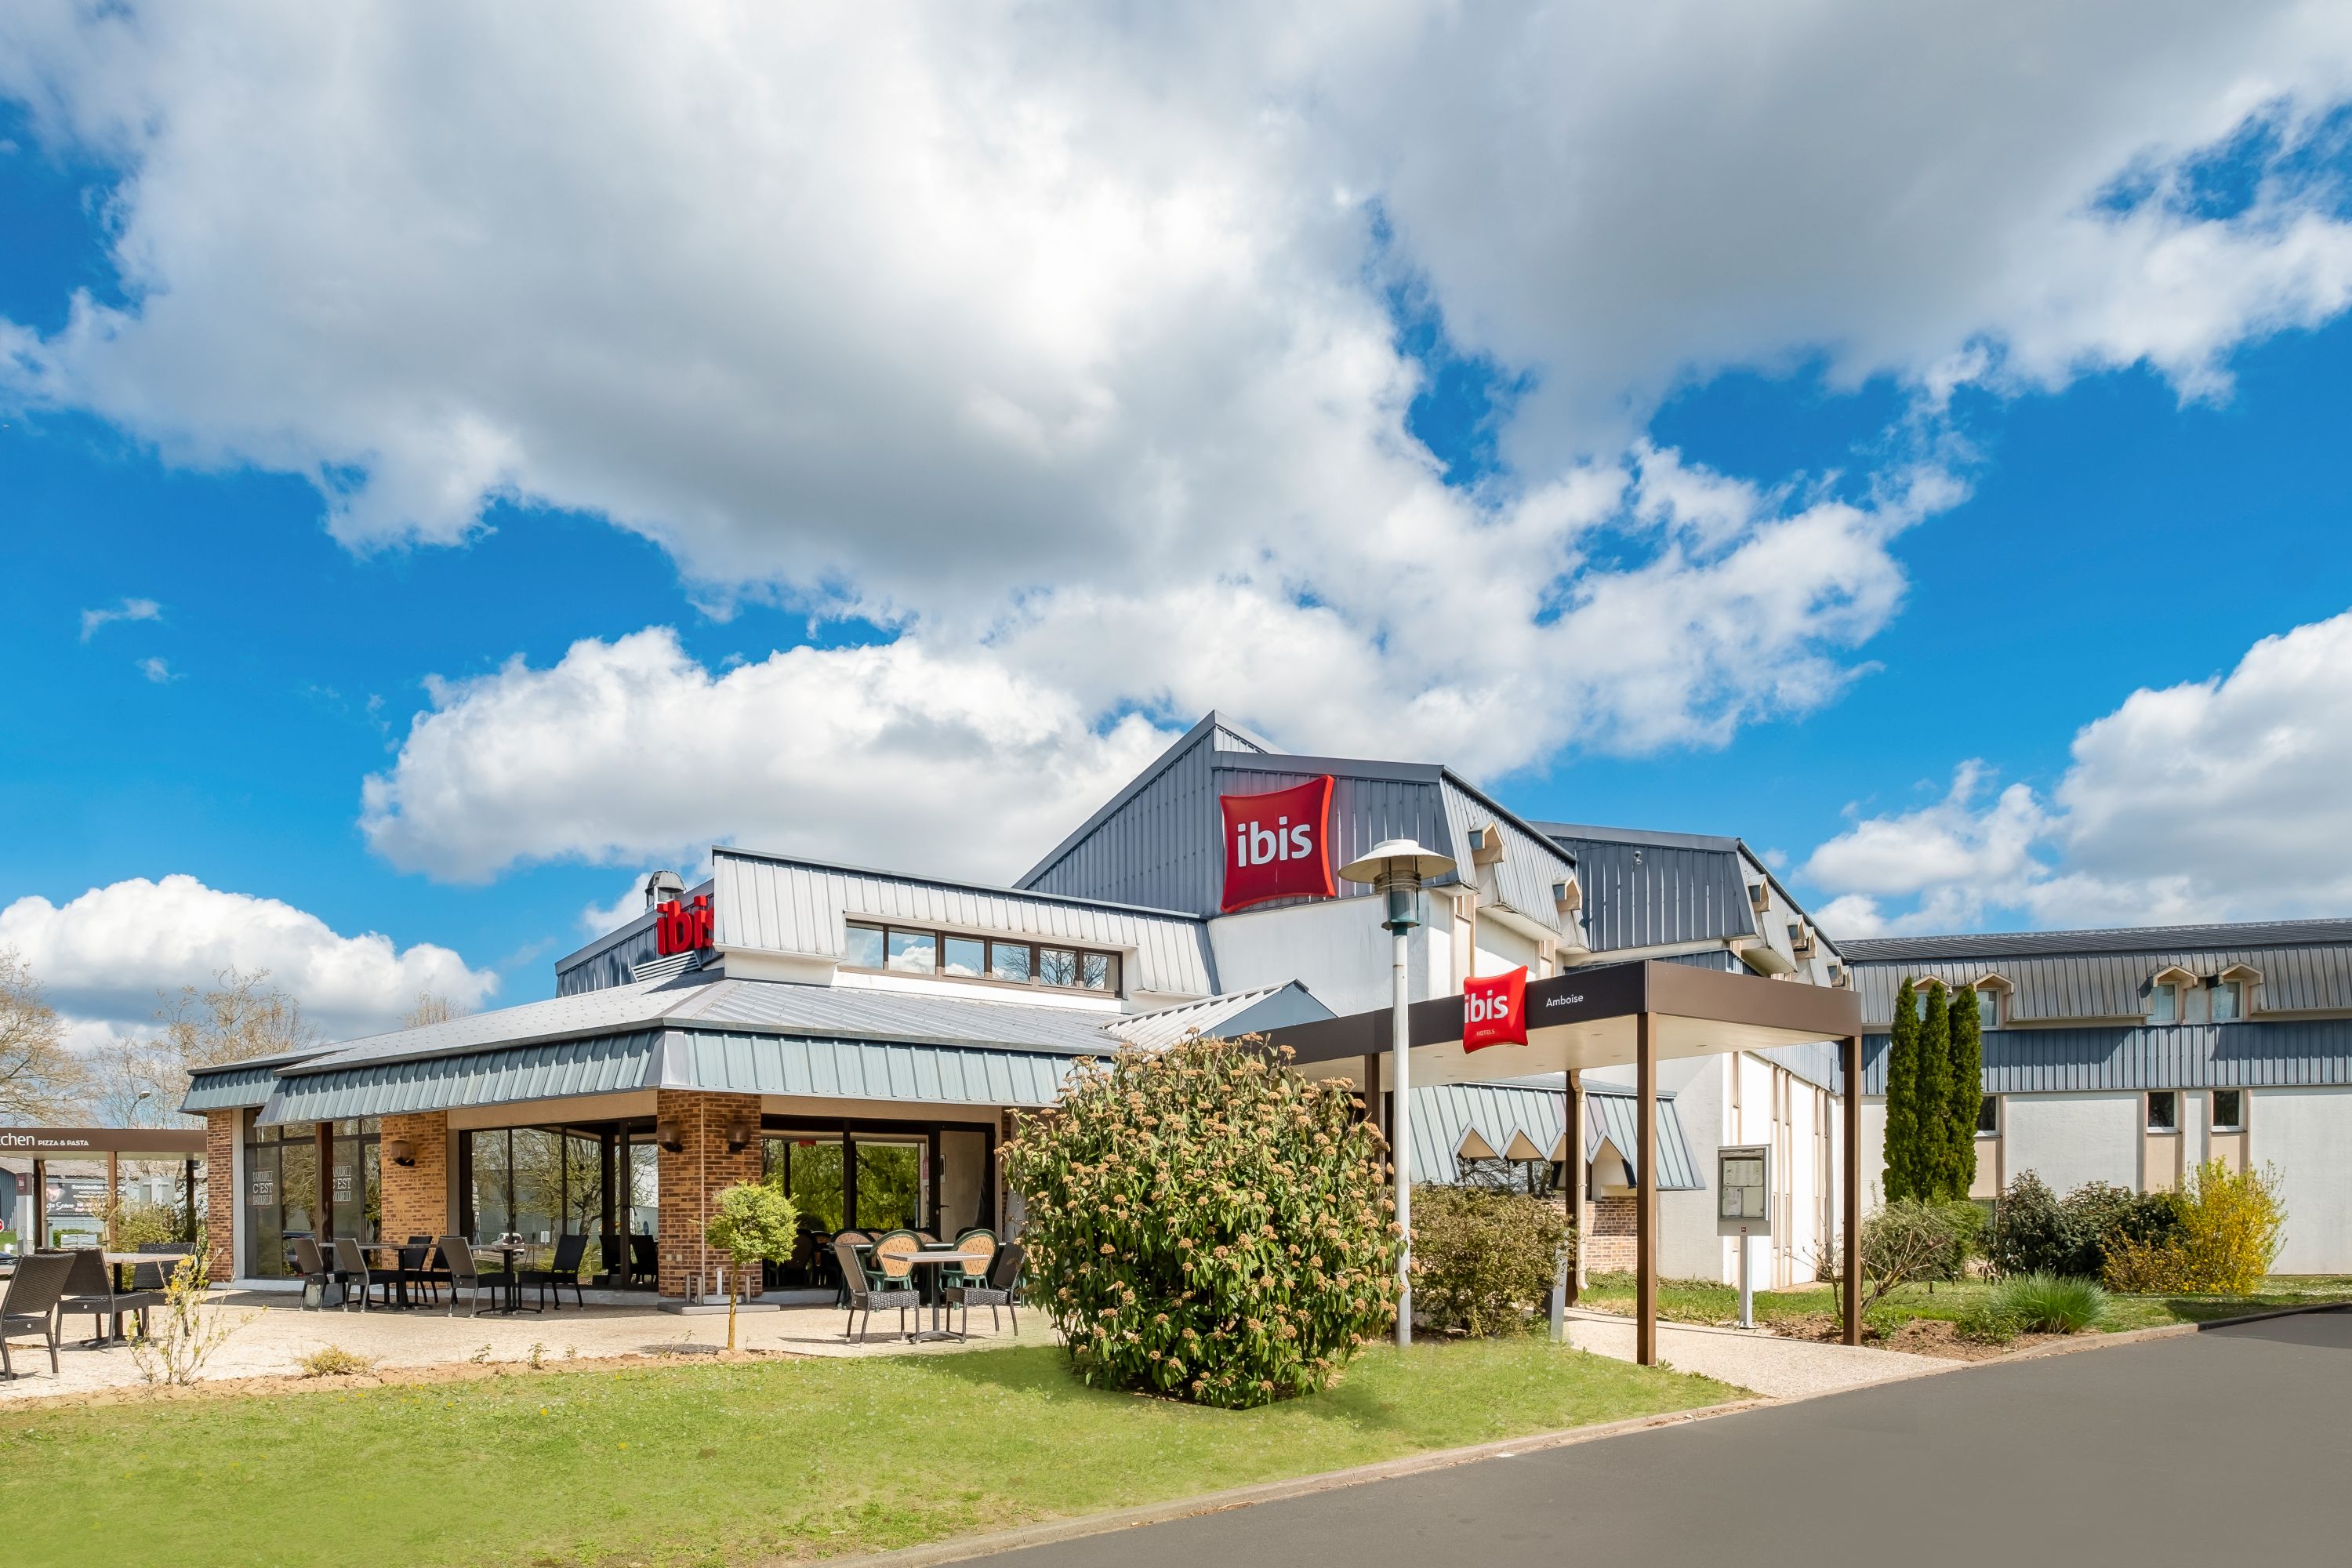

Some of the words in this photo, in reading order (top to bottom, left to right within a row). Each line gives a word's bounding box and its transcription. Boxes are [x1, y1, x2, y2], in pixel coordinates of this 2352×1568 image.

[1237, 816, 1312, 867] ibis
[1465, 989, 1509, 1023] ibis
[1545, 993, 1584, 1007] Amboise
[1476, 1028, 1496, 1036] HOTELS
[252, 1182, 274, 1193] C'EST
